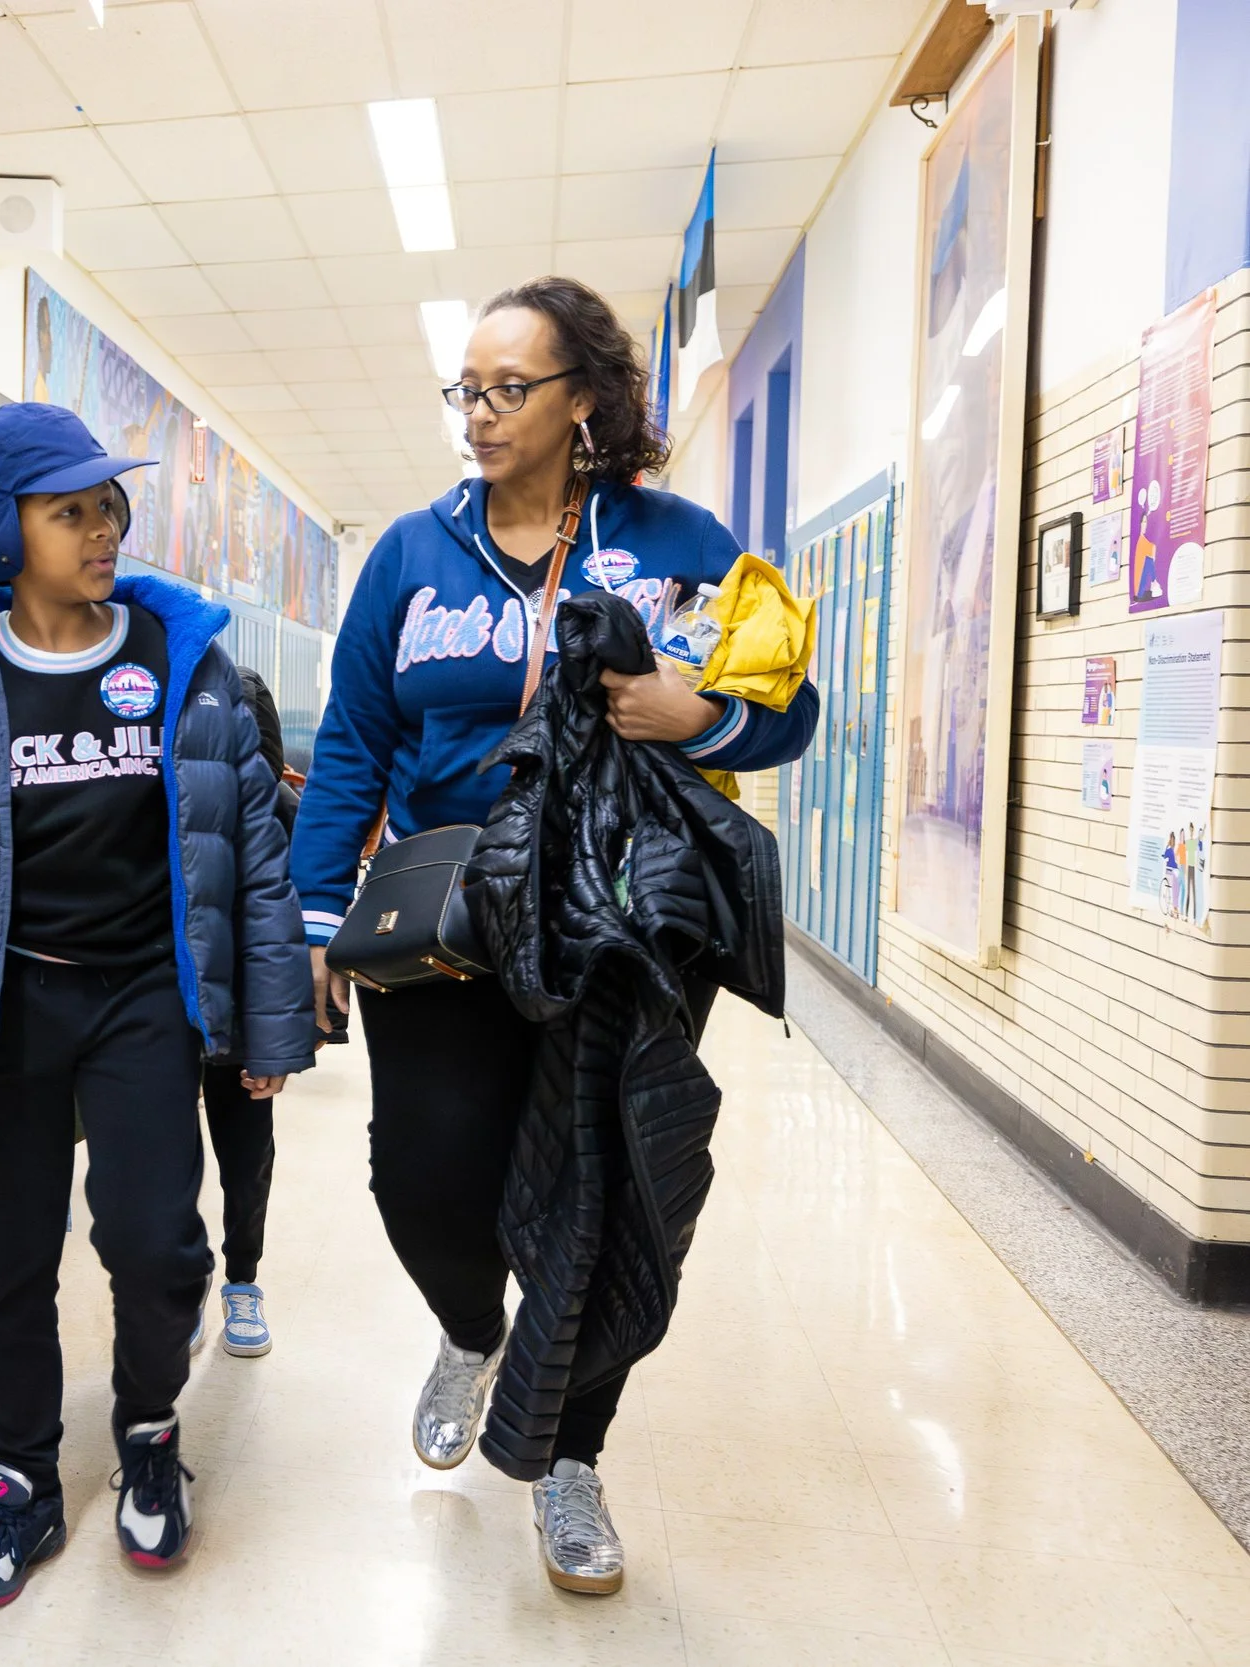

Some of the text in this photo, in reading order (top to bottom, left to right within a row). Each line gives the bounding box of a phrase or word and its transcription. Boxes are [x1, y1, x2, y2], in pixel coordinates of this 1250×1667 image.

[666, 643, 690, 658] WATER
[10, 726, 164, 769] CK & JIL
[10, 769, 22, 787] F
